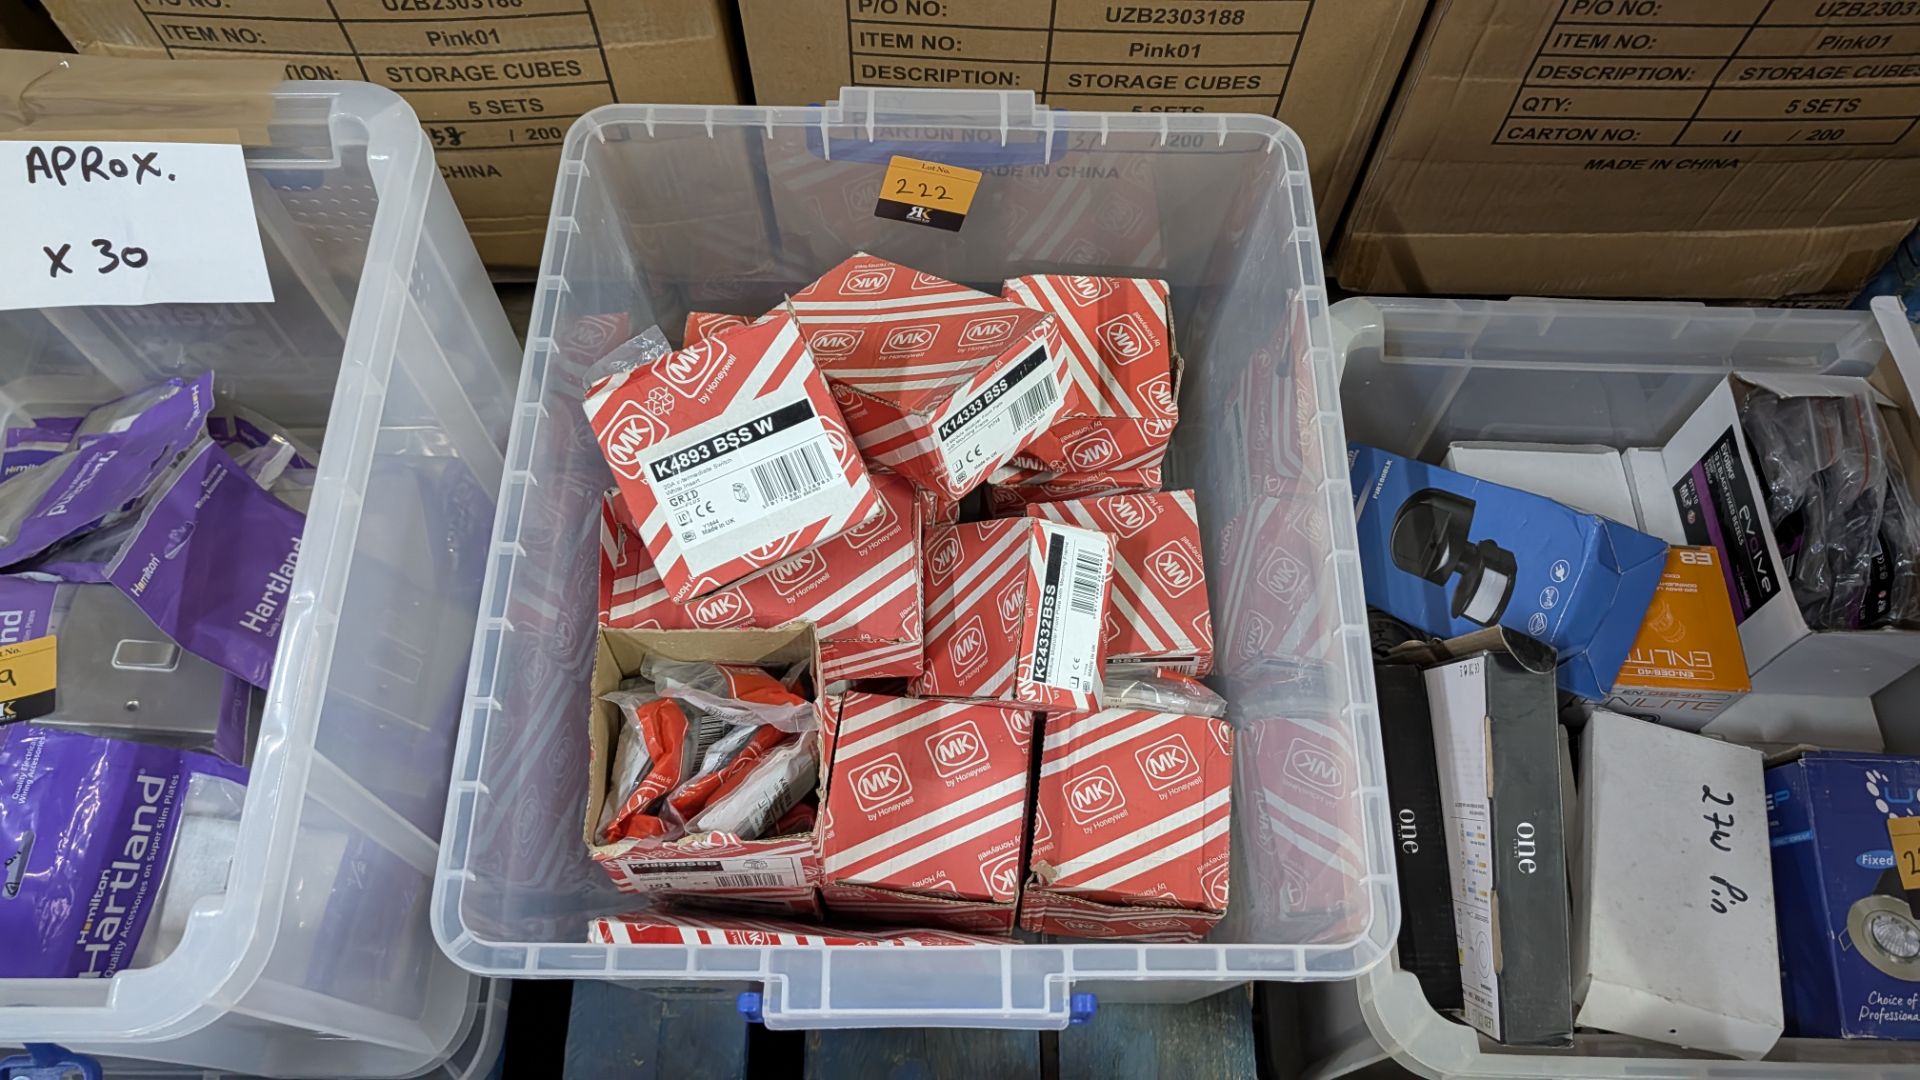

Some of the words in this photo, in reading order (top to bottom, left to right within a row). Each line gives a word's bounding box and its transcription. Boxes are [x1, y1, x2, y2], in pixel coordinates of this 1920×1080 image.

[859, 0, 899, 16] P/O
[906, 1, 948, 17] NO:
[1105, 7, 1246, 26] UZB2303188
[1571, 0, 1613, 16] P/O
[1617, 1, 1663, 17] NO:
[1815, 2, 1920, 18] UZB2303
[162, 24, 220, 43] ITEM
[220, 26, 266, 45] NO:
[425, 28, 501, 48] Pink01
[860, 32, 914, 49] ITEM
[921, 36, 962, 52] NO:
[1553, 33, 1611, 49] ITEM
[1613, 35, 1658, 50] NO:
[1816, 35, 1893, 50] Pink01
[1128, 42, 1202, 59] Pink01
[386, 65, 498, 83] STORAGE
[503, 60, 582, 80] CUBES
[861, 64, 1021, 87] DESCRIPTION:
[1067, 73, 1178, 90] STORAGE
[1184, 75, 1262, 90] CUBES
[1536, 65, 1696, 81] DESCRIPTION:
[1739, 66, 1853, 81] STORAGE
[469, 101, 482, 116] 5
[486, 98, 545, 115] SETS
[1522, 97, 1573, 112] QTY:
[1785, 100, 1801, 114] 5
[1803, 98, 1862, 113] SETS
[526, 127, 562, 141] 200
[1507, 127, 1599, 141] CARTON
[1600, 129, 1642, 142] NO:
[1805, 129, 1846, 142] 200
[1056, 164, 1120, 180] CHINA
[1584, 159, 1649, 170] MADE
[1650, 159, 1675, 170] IN
[1676, 158, 1740, 170] CHINA
[896, 178, 954, 201] 222
[91, 239, 149, 275] 30
[894, 331, 928, 344] MK
[969, 323, 1005, 336] MK
[1109, 325, 1138, 354] MK
[816, 336, 849, 349] MK
[669, 344, 709, 381] MK
[697, 391, 710, 405] by
[704, 353, 738, 395] Honeywell
[941, 400, 983, 438] K14333
[983, 378, 1009, 402] BSS
[611, 418, 651, 462] MK
[654, 440, 711, 477] K4893
[712, 427, 753, 454] BSS
[753, 416, 775, 435] W
[1078, 441, 1110, 466] MK
[1717, 465, 1729, 491] BLACK
[669, 489, 700, 508] GRID
[1112, 496, 1142, 526] MK
[866, 525, 902, 551] Honeywell
[1738, 504, 1772, 593] evolve
[1158, 553, 1190, 585] MK
[795, 572, 831, 598] Honeywell
[699, 594, 739, 622] MK
[1034, 584, 1057, 681] K24332BSS
[955, 635, 982, 661] MK
[938, 734, 975, 762] MK
[1149, 748, 1186, 776] MK
[861, 768, 899, 796] MK
[945, 779, 955, 788] by
[955, 762, 992, 784] Honeywell
[161, 774, 180, 807] Plates
[1074, 779, 1112, 808] MK
[1158, 791, 1168, 801] by
[1168, 775, 1203, 797] Honeywell
[156, 806, 168, 831] Slim
[867, 812, 877, 822] by
[878, 796, 915, 818] Honeywell
[1083, 826, 1093, 835] by
[1093, 809, 1129, 831] Honeywell
[1398, 808, 1419, 855] one
[147, 831, 163, 862] Super
[1516, 822, 1537, 874] one
[143, 861, 154, 878] on
[1861, 854, 1894, 867] Fixed
[121, 879, 149, 939] Accessories
[103, 939, 125, 979] Quality
[1867, 990, 1903, 1006] Choice
[1906, 991, 1919, 1010] of
